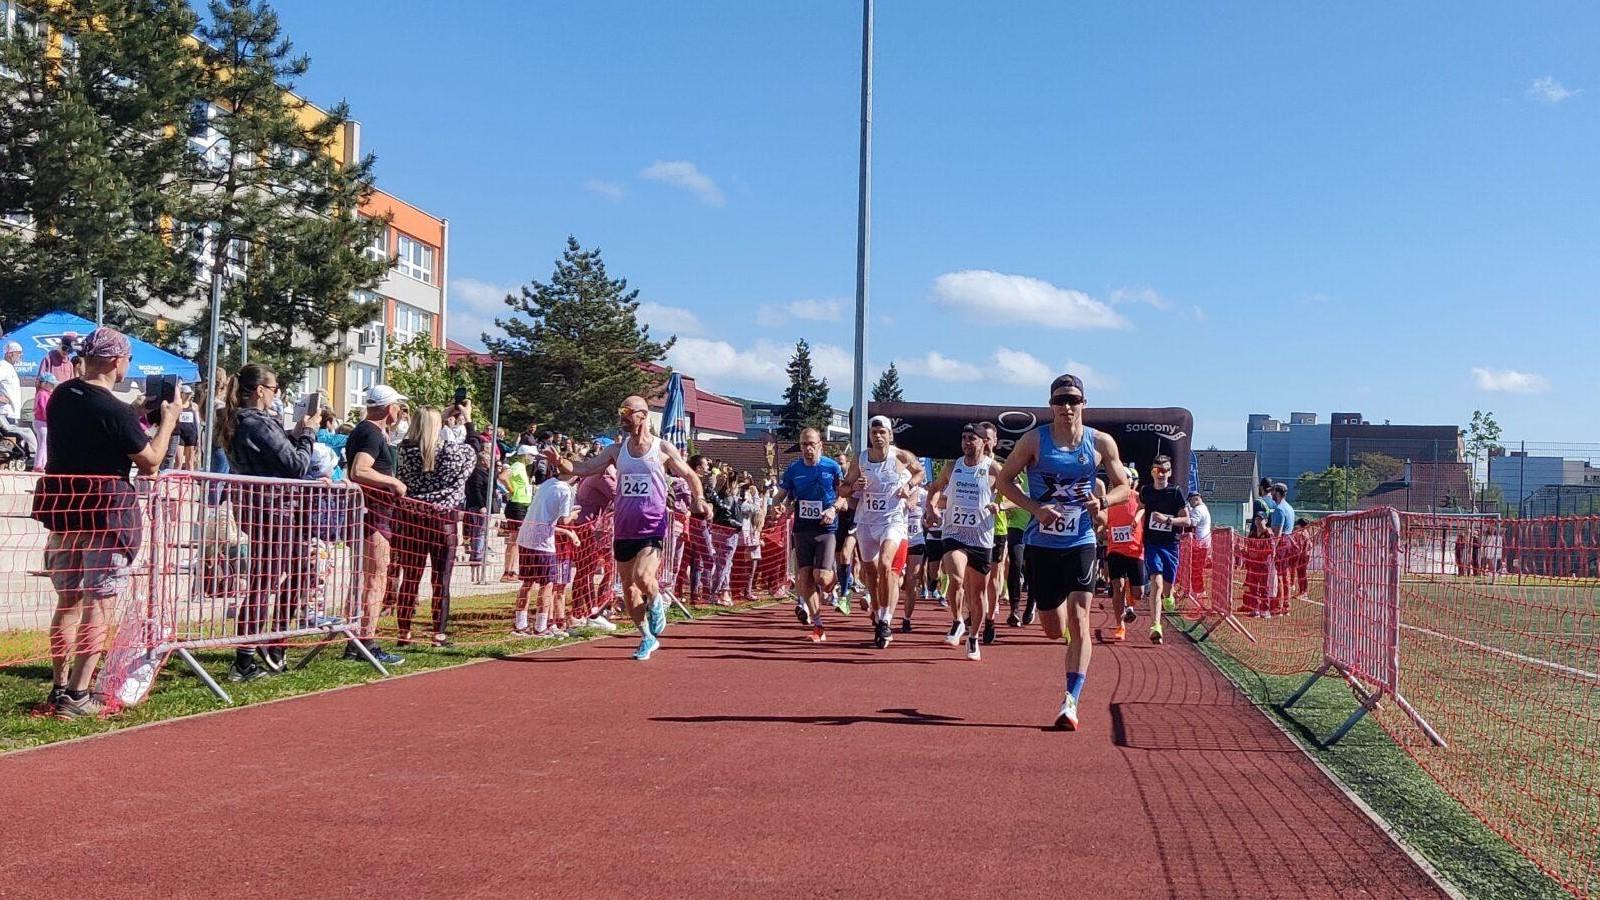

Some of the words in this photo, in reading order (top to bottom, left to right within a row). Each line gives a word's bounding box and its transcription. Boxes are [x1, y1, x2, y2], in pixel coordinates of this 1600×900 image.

[1126, 424, 1177, 434] saucony
[624, 482, 649, 495] 242
[866, 499, 886, 511] 162
[801, 506, 820, 517] 209
[953, 513, 976, 525] 273
[1114, 532, 1130, 541] 201
